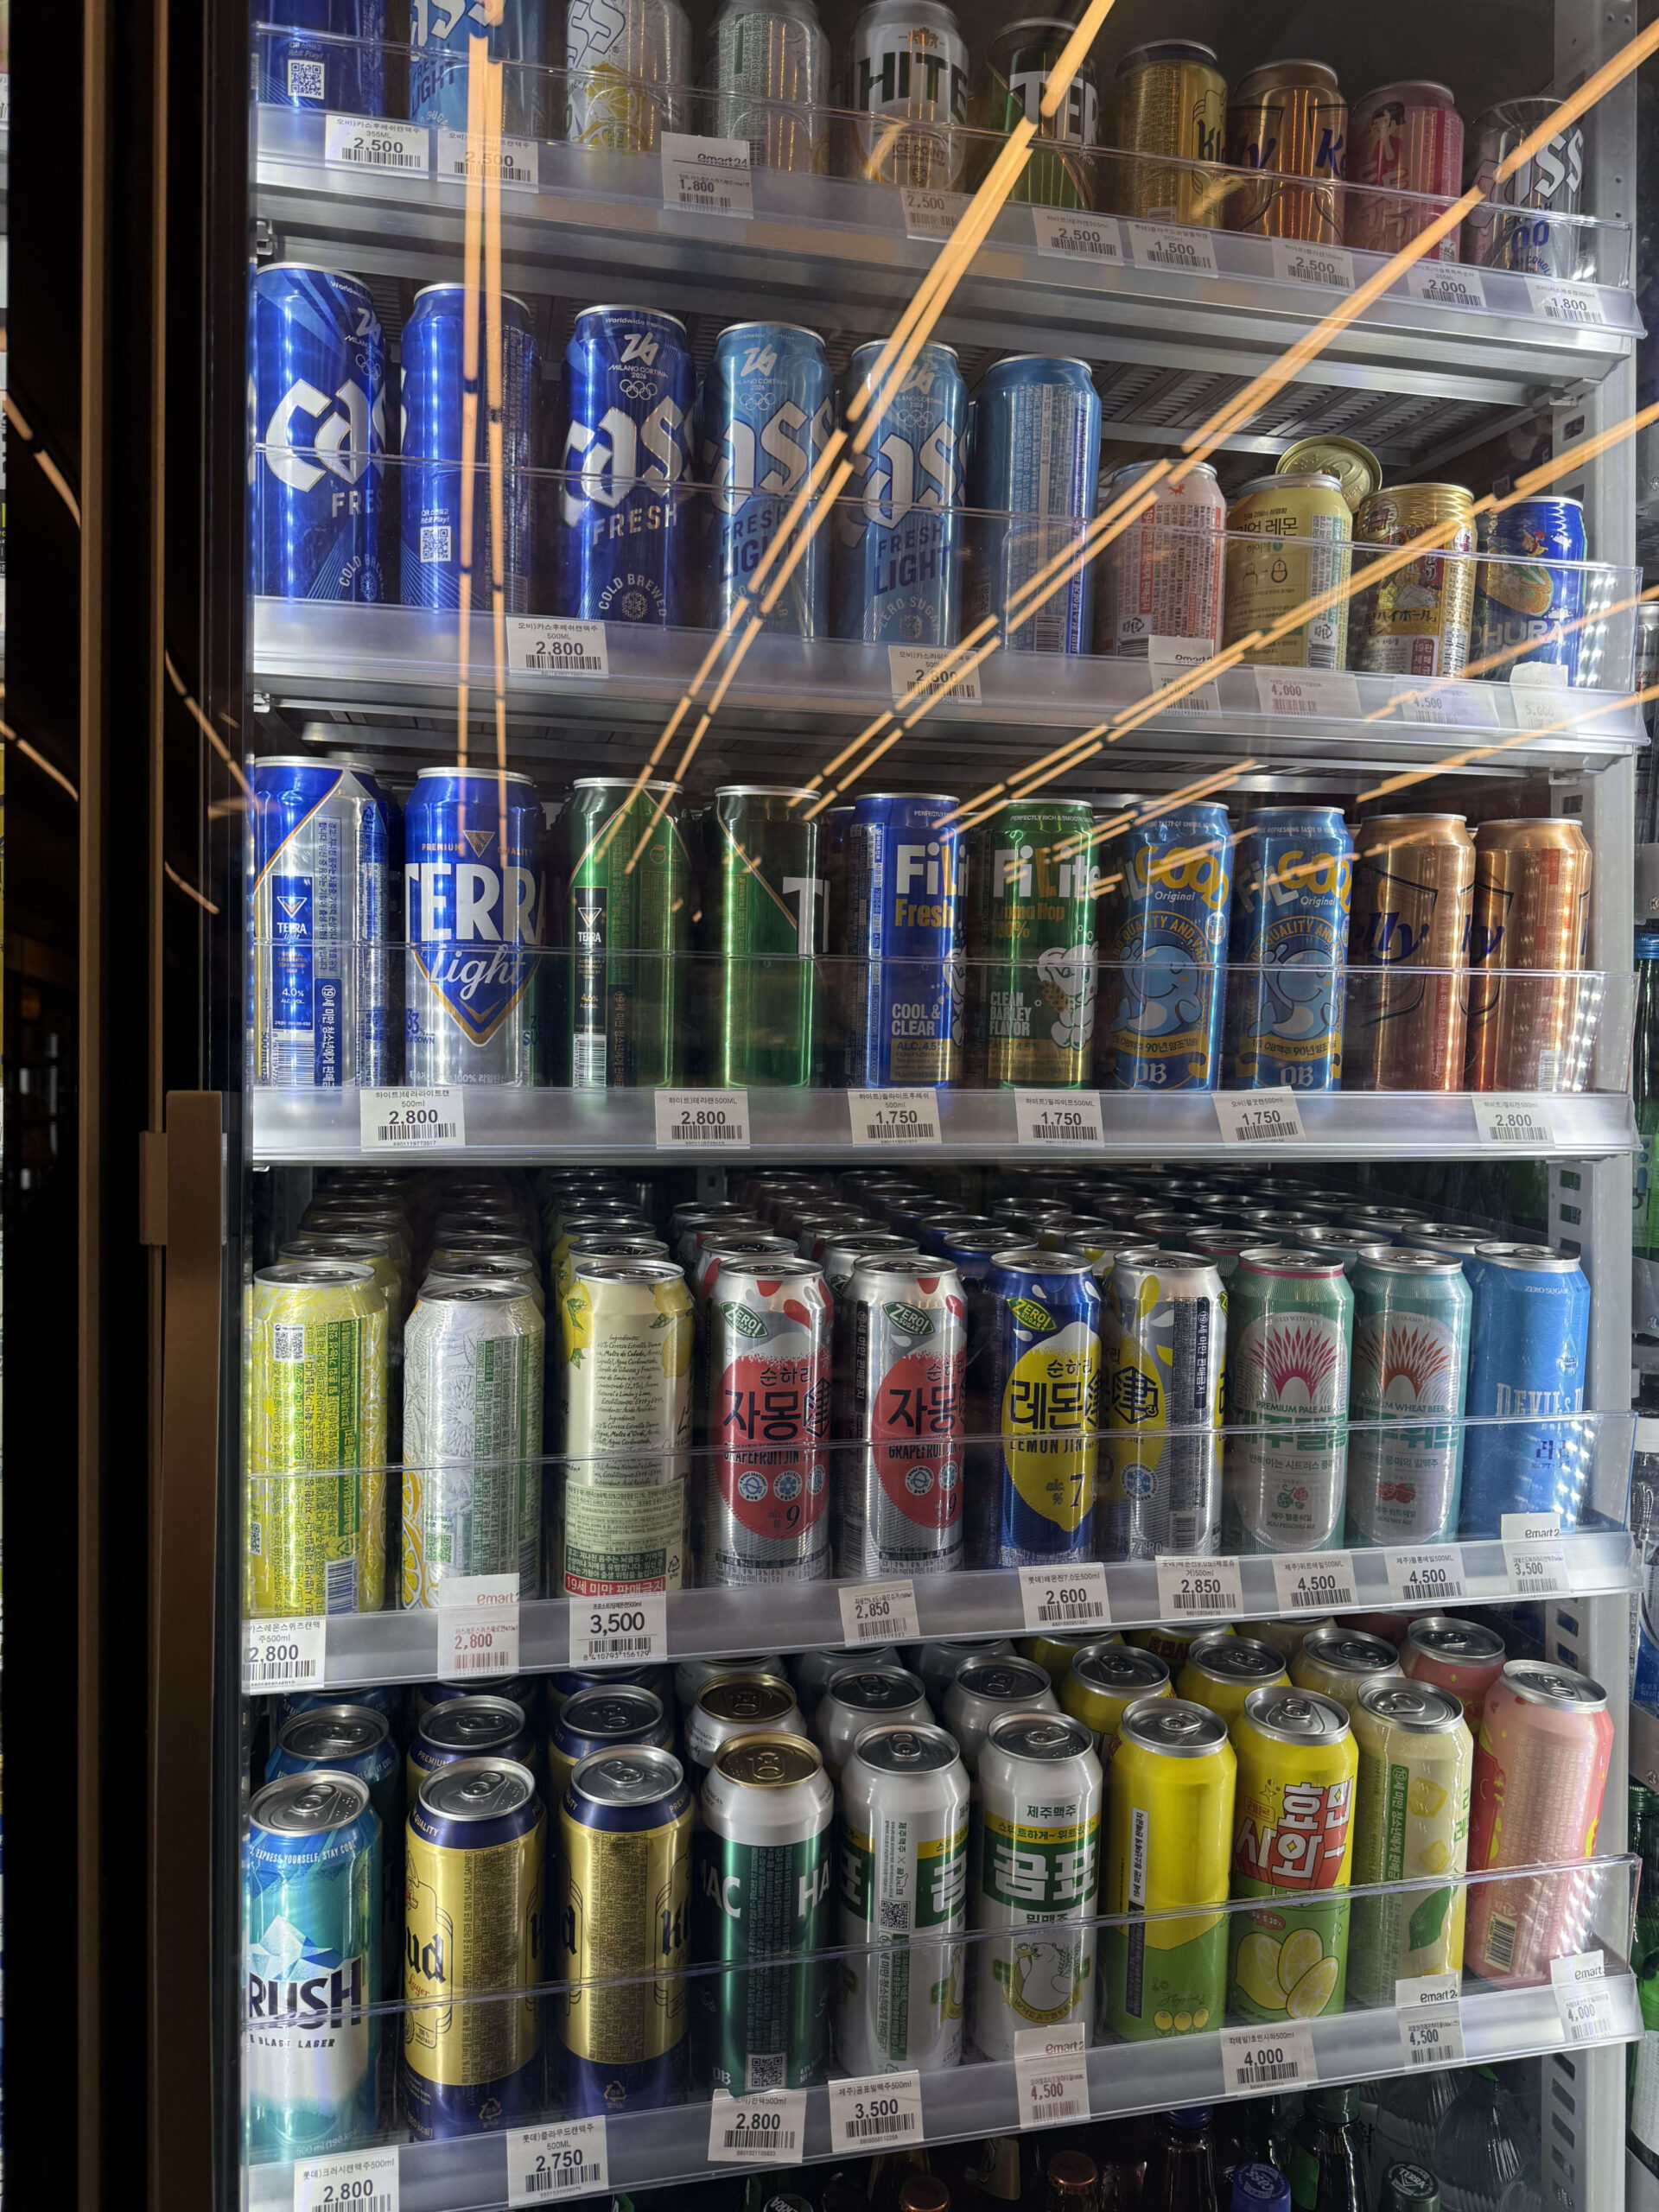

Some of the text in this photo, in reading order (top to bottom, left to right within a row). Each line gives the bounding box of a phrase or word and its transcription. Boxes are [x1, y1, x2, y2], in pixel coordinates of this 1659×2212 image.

[353, 137, 404, 154] 2,500
[678, 178, 715, 193] 1,800
[907, 198, 945, 211] 2,500
[1058, 227, 1101, 243] 2,500
[1154, 240, 1196, 256] 1,500
[1296, 256, 1336, 274] 2,500
[1428, 278, 1467, 294] 2,000
[1551, 296, 1587, 312] 1,800
[606, 317, 645, 327] Worldwide
[608, 364, 640, 373] MILANO
[593, 503, 677, 546] FRESH
[1265, 518, 1297, 536] 레몬
[878, 520, 944, 558] FRESH
[339, 555, 362, 588] COLD
[874, 546, 949, 596] LIGHT
[598, 573, 668, 618] COLD BREWED
[547, 632, 572, 641] 500ML
[536, 641, 584, 658] 2,800
[1271, 685, 1302, 697] 4,000
[421, 843, 461, 852] PREMIUM
[1154, 891, 1196, 902] Original
[1300, 895, 1337, 908] Original
[894, 899, 954, 928] Fresh
[1038, 903, 1065, 923] Hop
[276, 922, 308, 934] TERRA
[1171, 919, 1196, 939] AND
[578, 931, 602, 944] TERRA
[429, 944, 527, 1001] Light
[282, 988, 304, 997] 4.0%
[990, 992, 1024, 1007] CLEAN
[892, 1003, 941, 1020] COOL &
[989, 1007, 1032, 1021] BARLEY
[891, 1020, 935, 1036] CLEAR
[988, 1020, 1031, 1037] FLAVOR
[322, 1008, 335, 1065] 미만 청소년에게
[1146, 1040, 1168, 1053] 90년
[1294, 1045, 1315, 1056] 90년
[375, 1090, 449, 1100] 하이트)테라라이트캔
[402, 1099, 425, 1108] 500ml
[389, 1109, 439, 1125] 2,800
[681, 1110, 726, 1126] 2,800
[875, 1110, 918, 1125] 1,750
[1041, 1111, 1082, 1126] 1,750
[1242, 1109, 1281, 1126] 1,750
[1495, 1114, 1533, 1128] 2,800
[1524, 1286, 1545, 1294] ZERO
[1046, 1357, 1093, 1376] 순하리
[1196, 1336, 1207, 1395] 미만 판매금지
[760, 1366, 813, 1386] 순하리
[1010, 1379, 1084, 1431] 레몬
[1255, 1401, 1297, 1413] PREMIUM
[1299, 1405, 1317, 1414] PALE
[1395, 1402, 1427, 1412] WHEAT
[722, 1388, 798, 1441] 자몽
[1285, 1458, 1320, 1470] 시트러스
[1069, 1473, 1085, 1508] 7
[785, 1504, 801, 1531] 9
[1185, 1568, 1214, 1577] 거)500ml
[1409, 1569, 1446, 1585] 4,500
[1515, 1562, 1544, 1576] 3,500
[589, 1582, 613, 1596] 미만
[1180, 1579, 1221, 1594] 2,850
[1298, 1575, 1336, 1592] 4,500
[1046, 1588, 1087, 1605] 2,600
[855, 1602, 891, 1619] 2,850
[589, 1611, 645, 1637] 3,500
[258, 1634, 290, 1643] 주500ml
[454, 1633, 493, 1649] 2,800
[250, 1644, 299, 1662] 2,800
[622, 1649, 650, 1659] 156129
[1026, 1803, 1078, 1820] 제주맥주
[1389, 1792, 1405, 1853] 미만 청소년에게
[256, 1850, 283, 1865] EXPRESS
[322, 1847, 340, 1861] STAY
[992, 1840, 1096, 1902] 곰표
[1567, 2005, 1596, 2022] 4,000
[298, 2037, 336, 2049] LAGER
[1409, 2030, 1440, 2045] 4,500
[1244, 2047, 1284, 2067] 4,000
[1031, 2082, 1065, 2101] 4,500
[855, 2098, 899, 2120] 3,500
[735, 2112, 781, 2132] 2,800
[546, 2139, 572, 2151] 500ML
[535, 2150, 584, 2172] 2,750
[323, 2178, 373, 2205] 2,800
